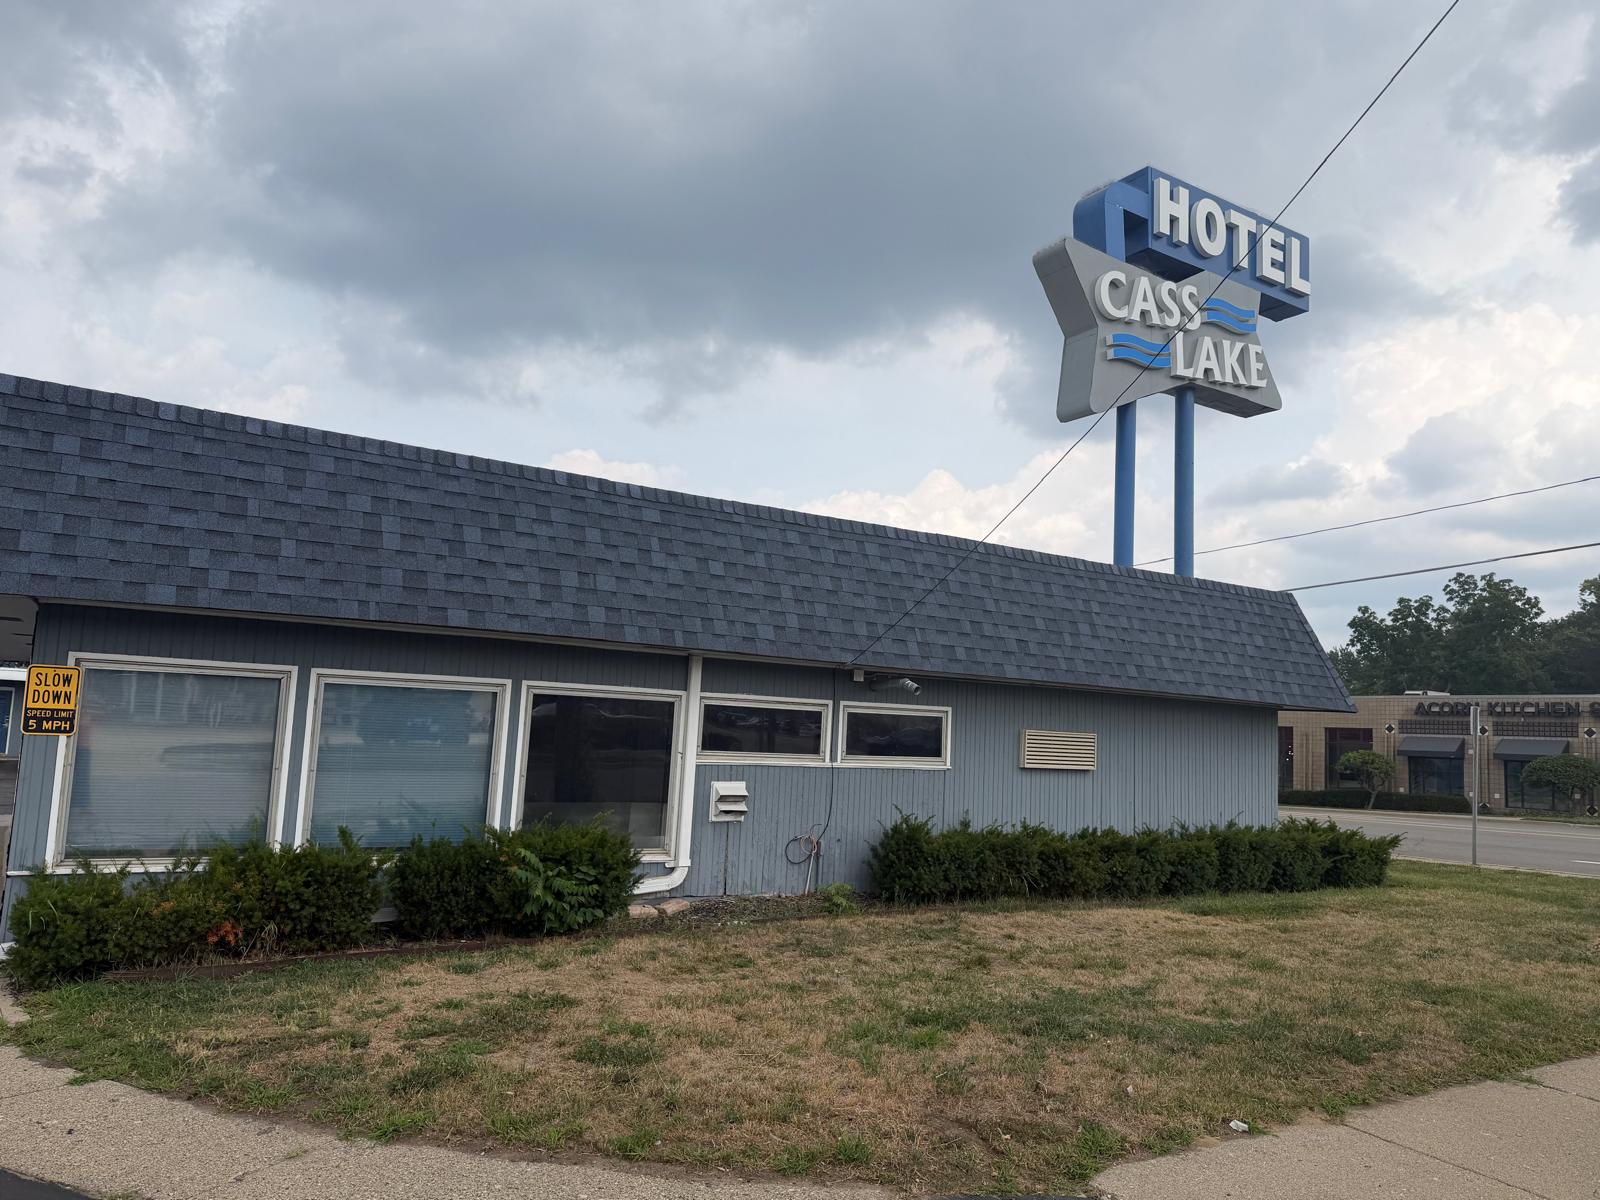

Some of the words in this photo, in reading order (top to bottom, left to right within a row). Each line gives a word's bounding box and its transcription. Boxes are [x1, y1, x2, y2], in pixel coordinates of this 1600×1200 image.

[1153, 177, 1311, 297] HOTEL
[1095, 271, 1201, 331] CASS
[1169, 330, 1267, 388] LAKE
[35, 672, 72, 687] SLOW
[32, 690, 71, 704] DOWN
[1487, 702, 1580, 717] KITCHEN
[28, 720, 36, 729] 5
[43, 721, 69, 730] MPH
